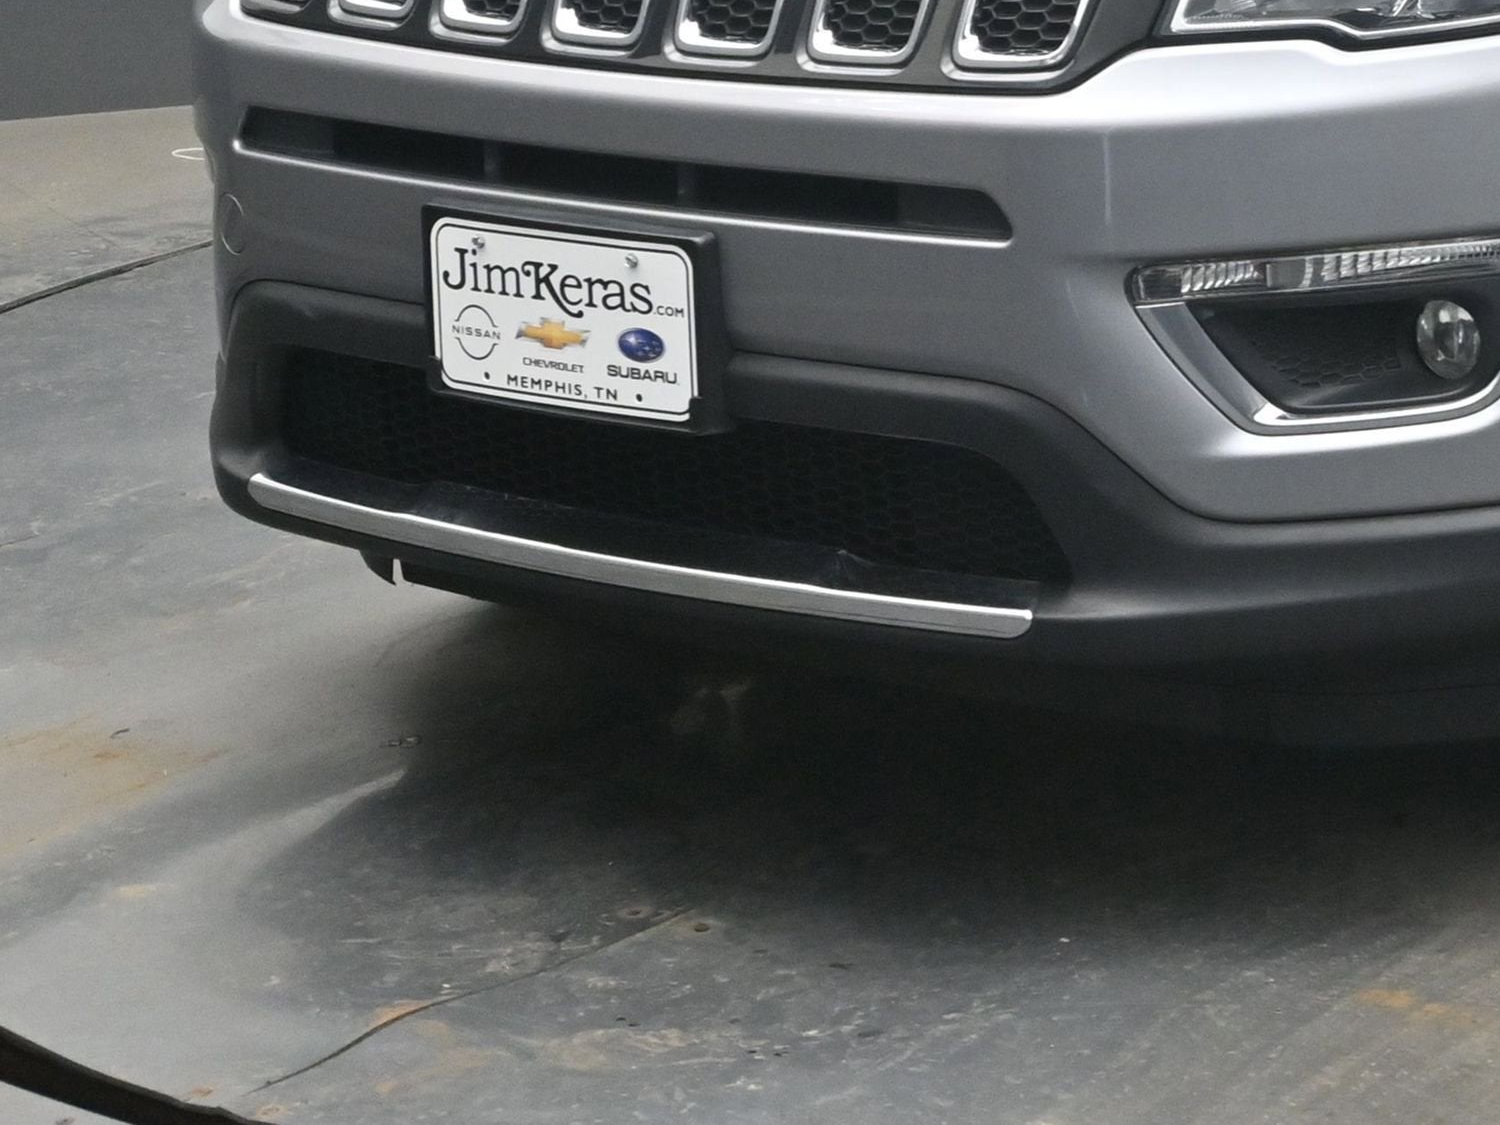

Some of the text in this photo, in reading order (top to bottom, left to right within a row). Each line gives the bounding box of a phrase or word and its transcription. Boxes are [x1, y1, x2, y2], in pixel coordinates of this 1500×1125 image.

[452, 324, 500, 341] NISSAN
[522, 357, 584, 374] CHEVROLET
[606, 364, 677, 385] SUBARU
[506, 374, 618, 401] MEMPHIS, TN
